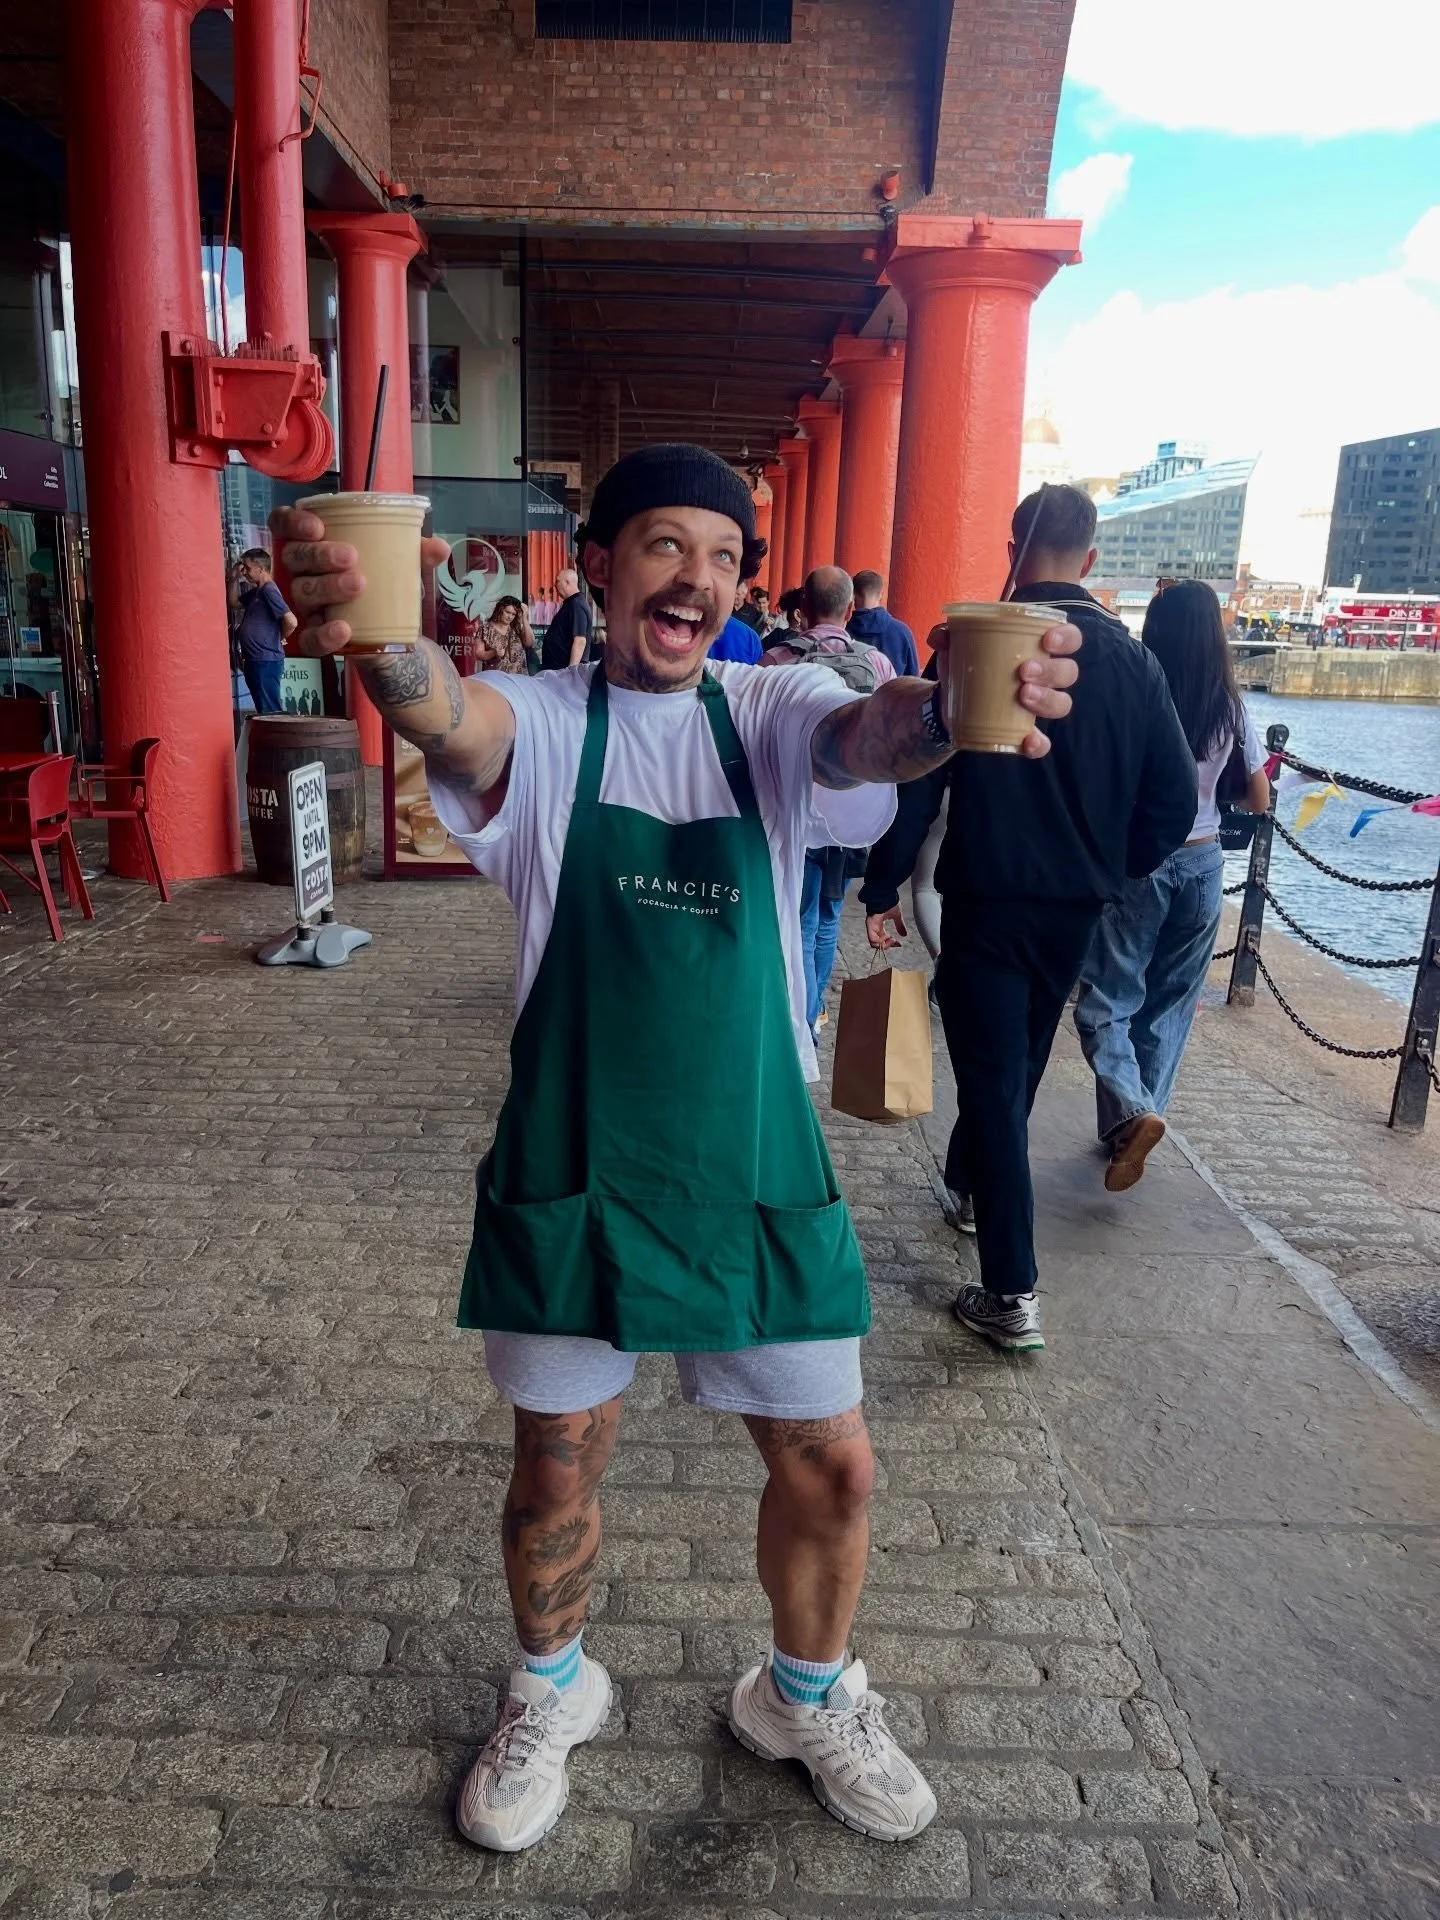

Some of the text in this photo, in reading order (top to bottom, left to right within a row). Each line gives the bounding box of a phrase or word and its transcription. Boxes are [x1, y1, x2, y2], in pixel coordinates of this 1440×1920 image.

[296, 775, 323, 811] OPEN
[303, 807, 321, 829] UNTIL
[302, 826, 327, 860] 9PM
[305, 863, 329, 891] COSTA
[618, 875, 740, 903] FRANCIE'S
[637, 898, 679, 910] FOCACCIA
[690, 907, 719, 915] COFFEE
